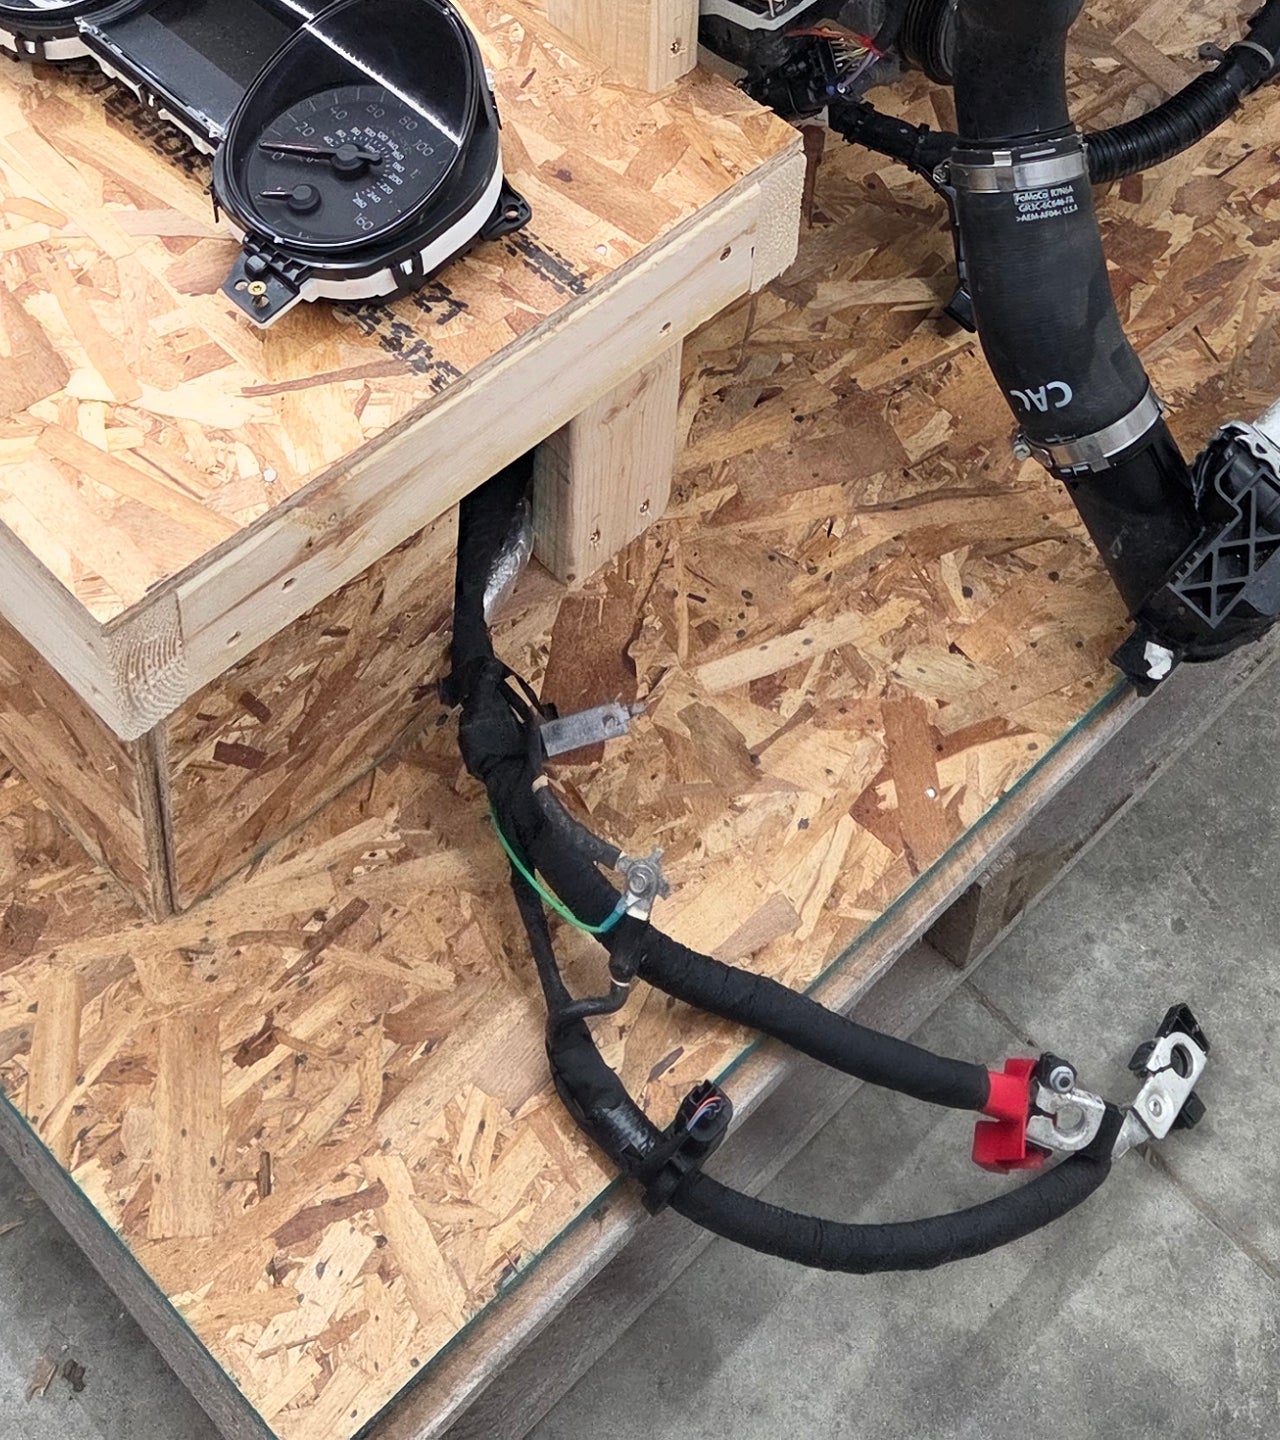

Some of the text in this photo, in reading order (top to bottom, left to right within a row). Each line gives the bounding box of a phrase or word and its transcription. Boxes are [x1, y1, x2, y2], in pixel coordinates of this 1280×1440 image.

[331, 107, 347, 120] 40
[296, 123, 315, 137] 20
[413, 139, 434, 157] 100
[1014, 190, 1049, 204] FoMoCo
[354, 212, 374, 230] 160
